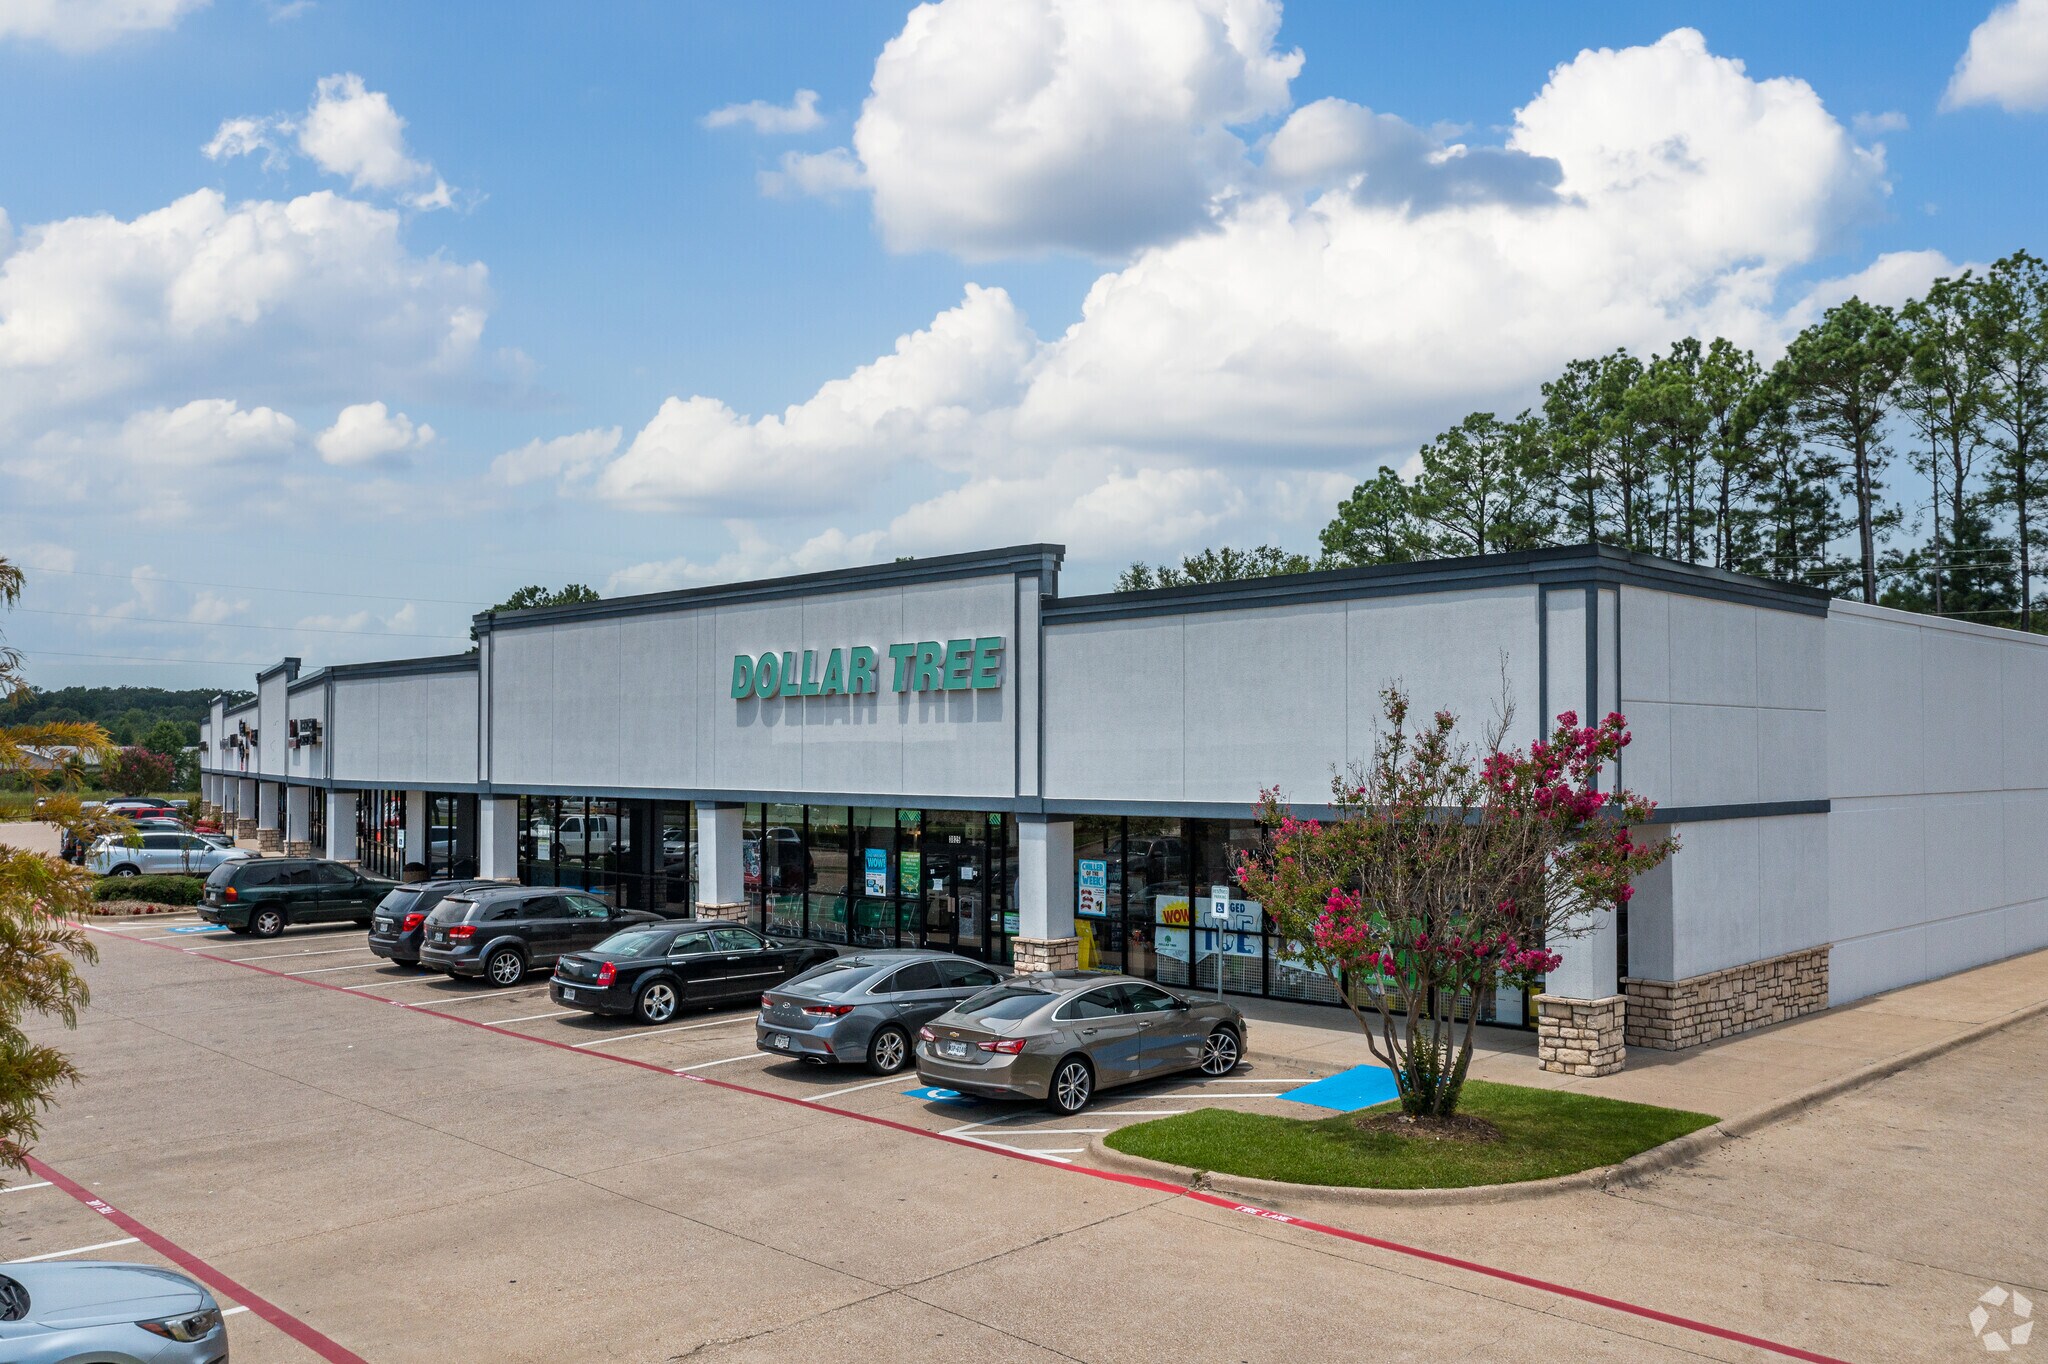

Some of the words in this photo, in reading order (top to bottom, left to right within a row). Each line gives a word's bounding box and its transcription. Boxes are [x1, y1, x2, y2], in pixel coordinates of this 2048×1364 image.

[731, 645, 879, 699] DOLLAR
[888, 636, 1006, 693] TREE
[1082, 863, 1104, 871] CHILLER
[1082, 876, 1104, 886] WEEK!
[1235, 1205, 1262, 1214] FIRE
[1261, 1211, 1293, 1222] LANE
